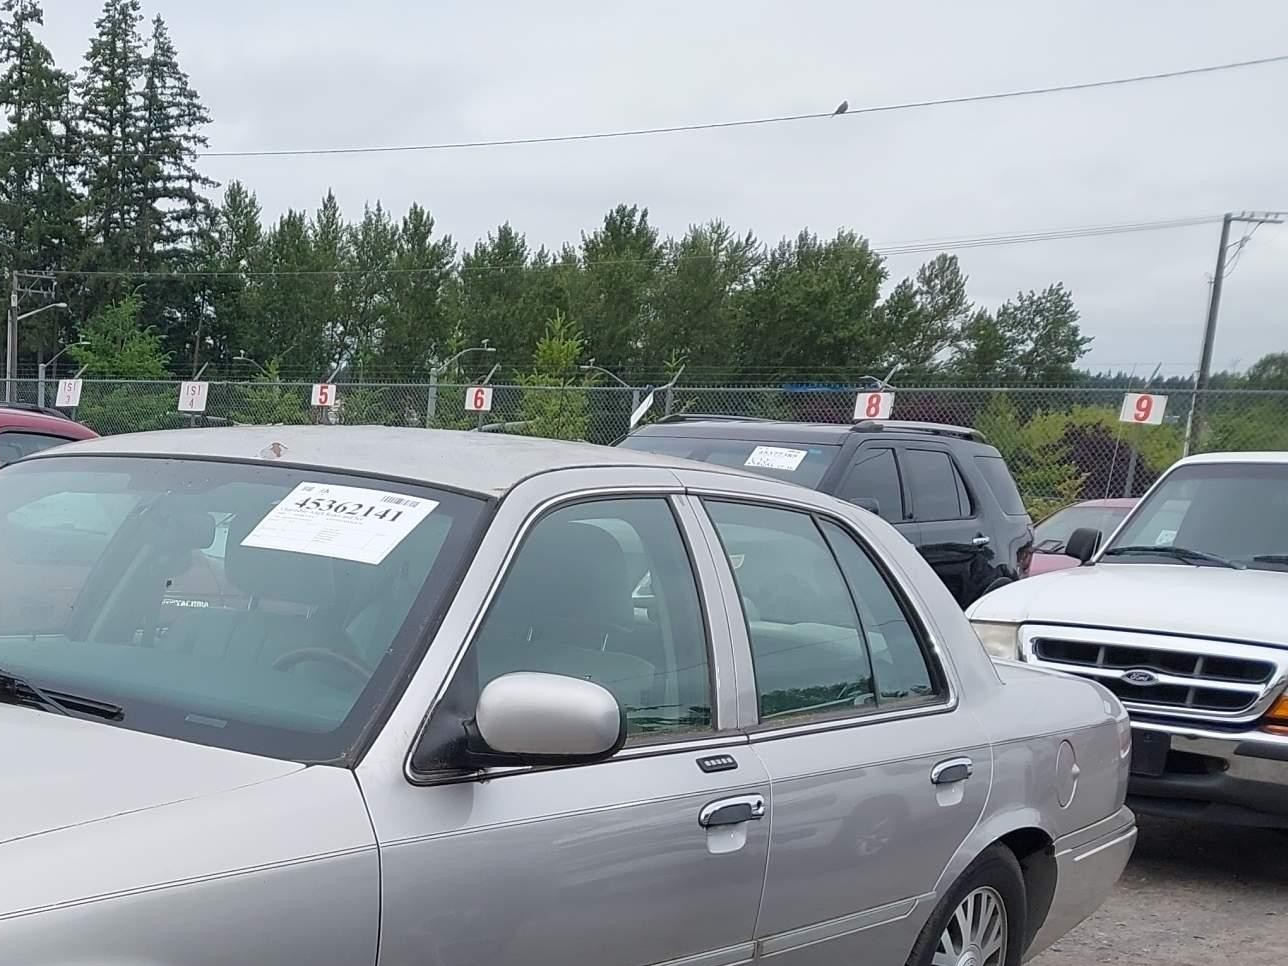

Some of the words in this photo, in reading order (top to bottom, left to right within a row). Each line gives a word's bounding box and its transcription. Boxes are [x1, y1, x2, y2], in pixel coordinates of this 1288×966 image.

[188, 398, 195, 409] 4
[318, 386, 329, 405] 5
[473, 389, 484, 409] 6
[866, 394, 881, 417] 8
[1135, 395, 1153, 421] 9
[294, 497, 404, 522] 45362141
